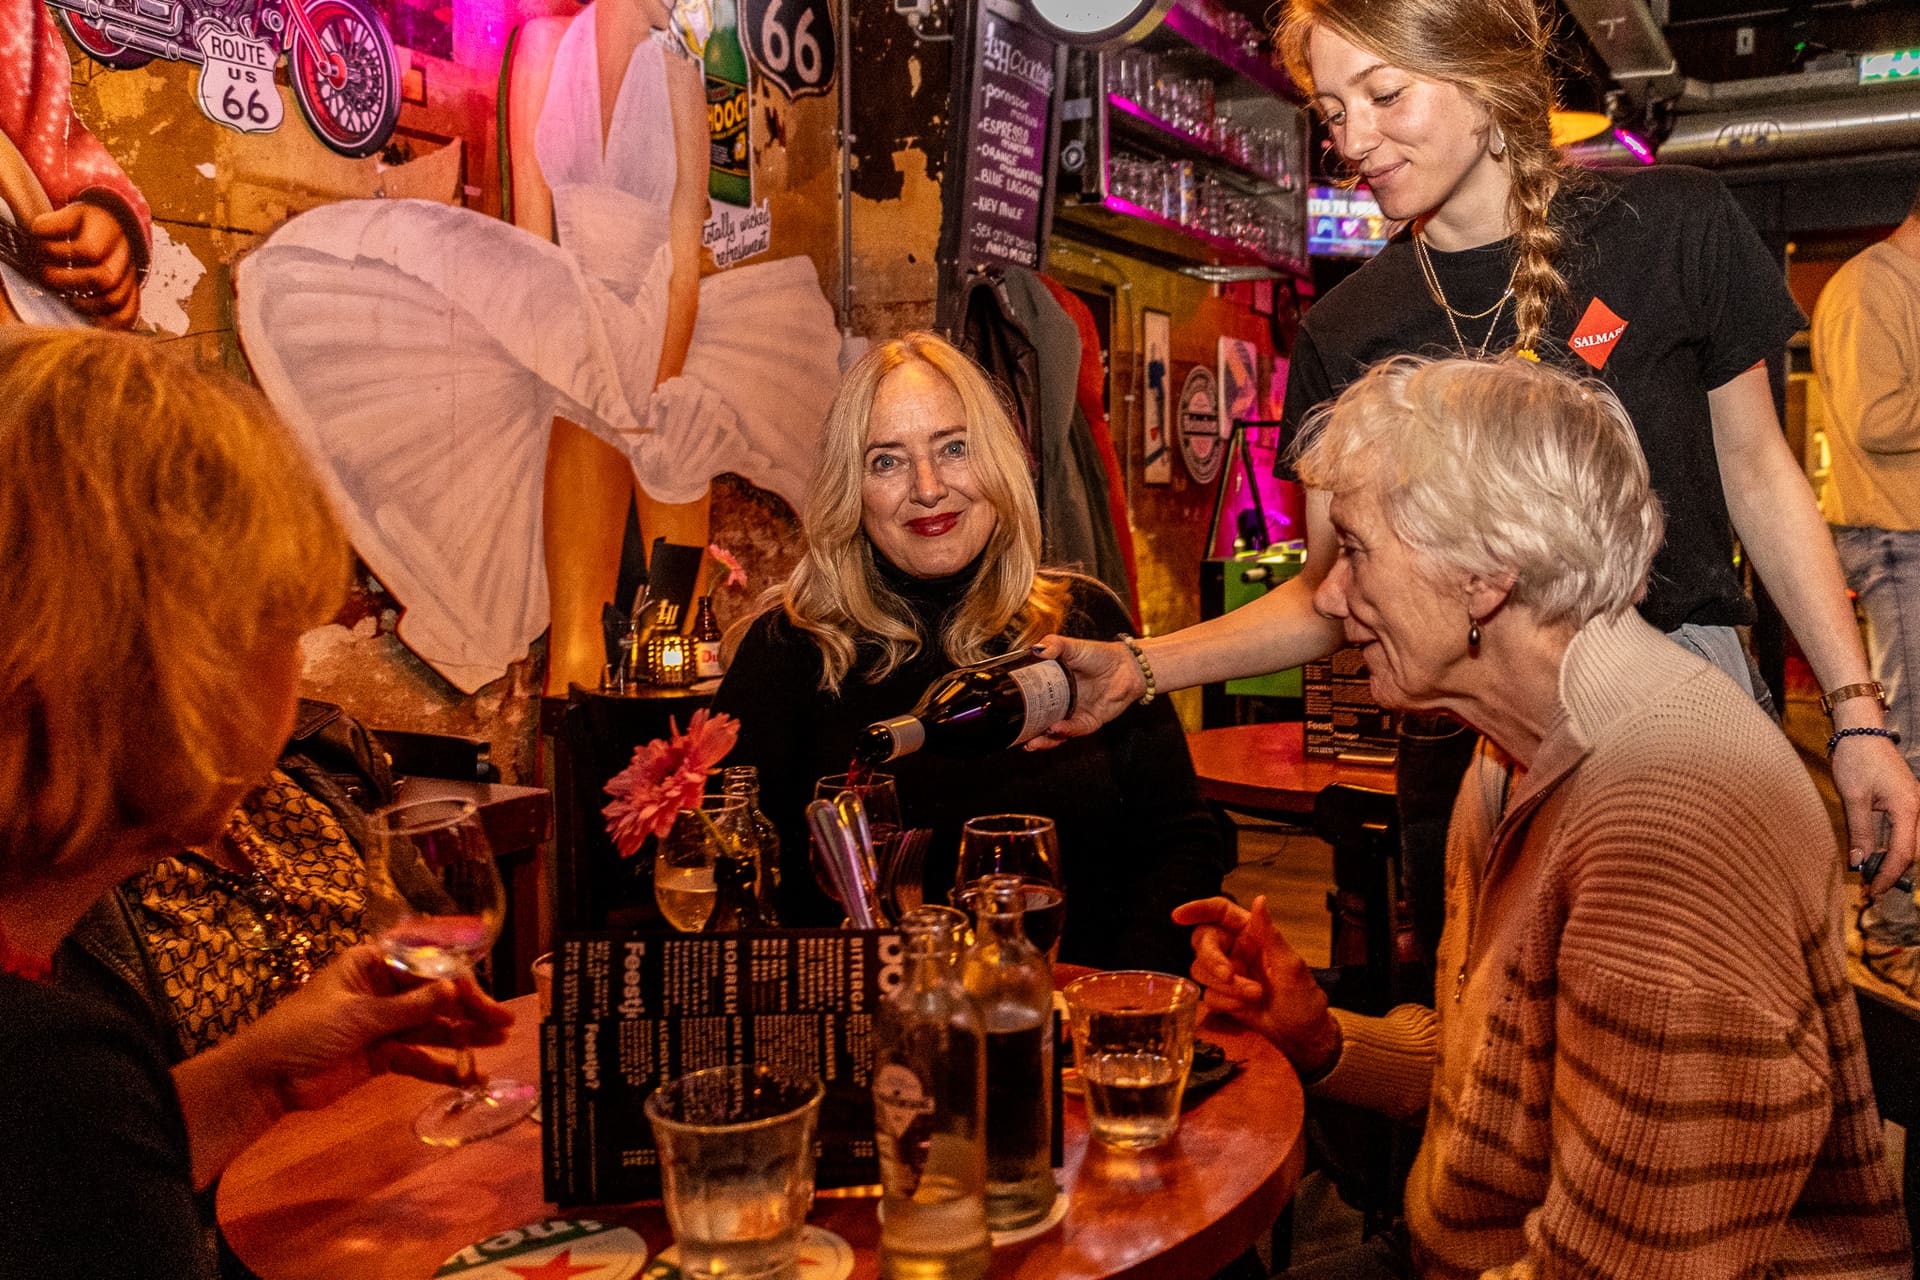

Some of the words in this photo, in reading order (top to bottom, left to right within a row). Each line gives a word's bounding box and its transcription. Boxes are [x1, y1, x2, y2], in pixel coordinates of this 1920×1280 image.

[211, 36, 267, 66] ROUTE
[762, 0, 822, 85] 66
[227, 67, 257, 83] US
[222, 85, 269, 124] 66
